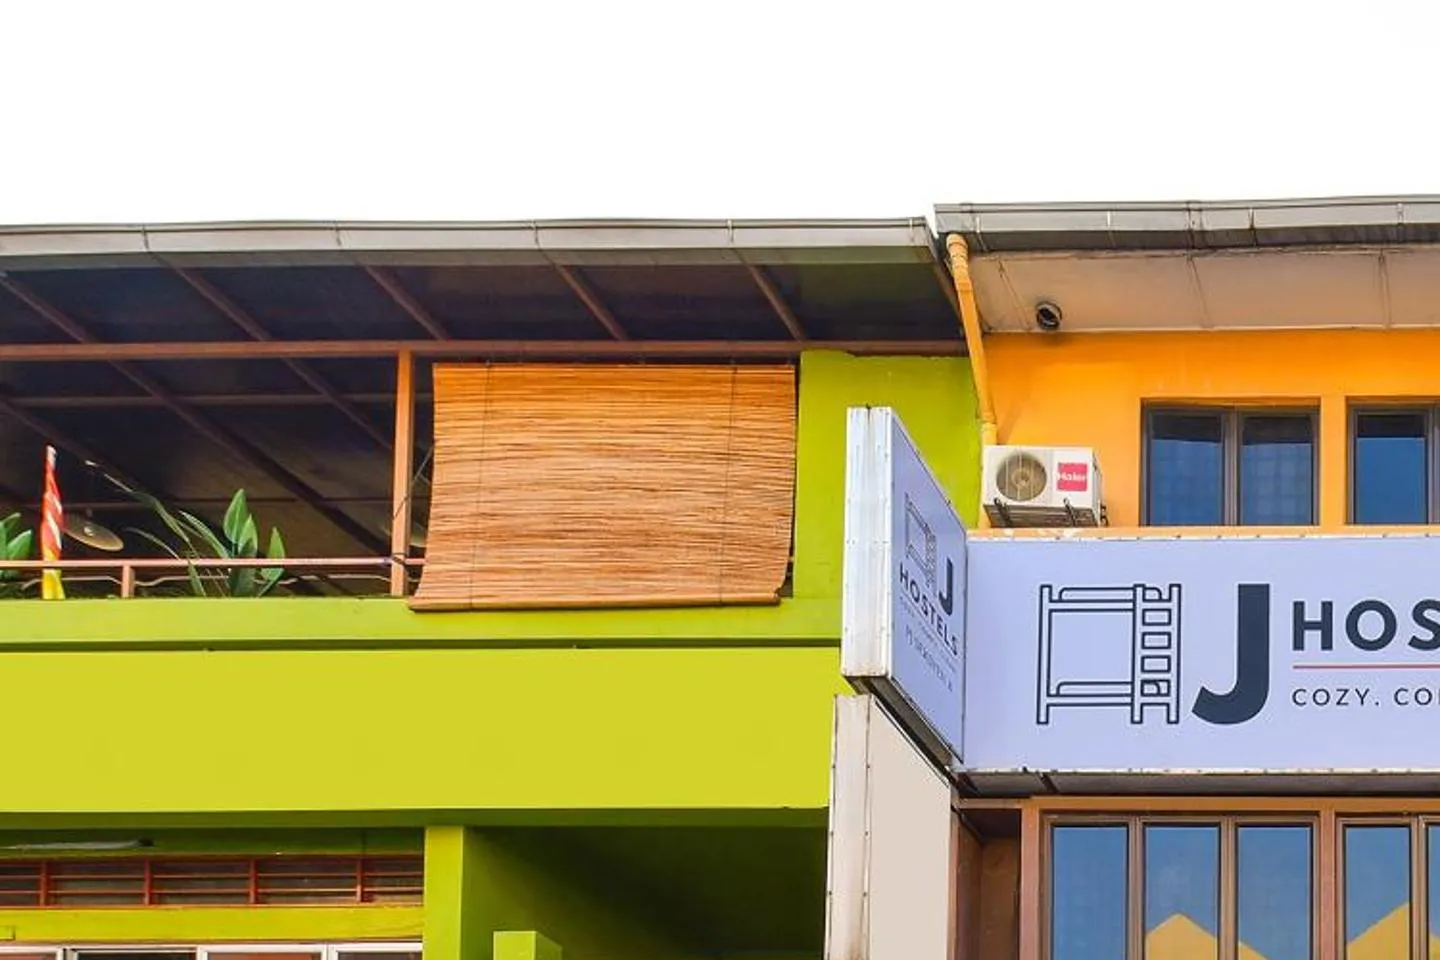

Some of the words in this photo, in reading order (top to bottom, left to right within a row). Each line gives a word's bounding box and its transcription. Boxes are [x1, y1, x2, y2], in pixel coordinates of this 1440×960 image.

[900, 562, 958, 656] HOSTELS
[1191, 583, 1271, 725] J
[1292, 687, 1380, 707] COZY.
